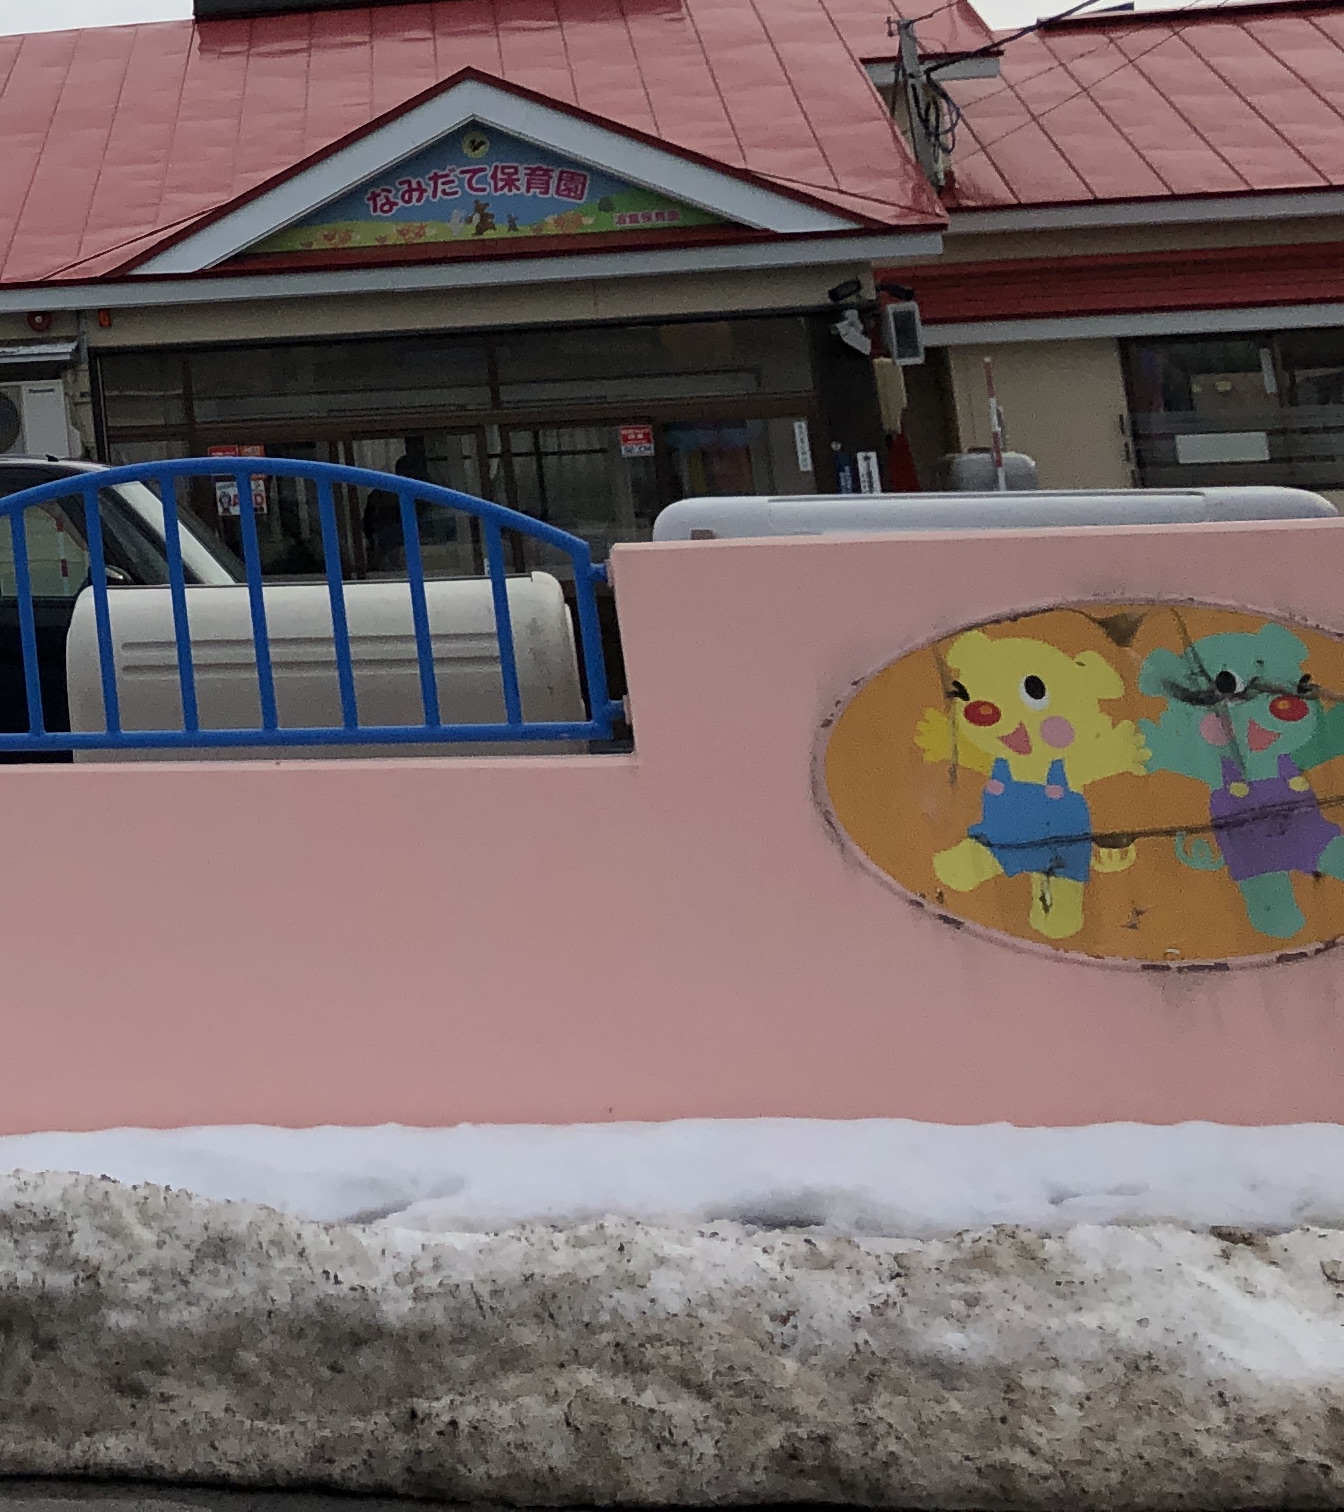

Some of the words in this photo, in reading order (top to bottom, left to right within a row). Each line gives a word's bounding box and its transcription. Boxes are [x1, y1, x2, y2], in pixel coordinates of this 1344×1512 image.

[366, 162, 590, 216] なみだて保育園
